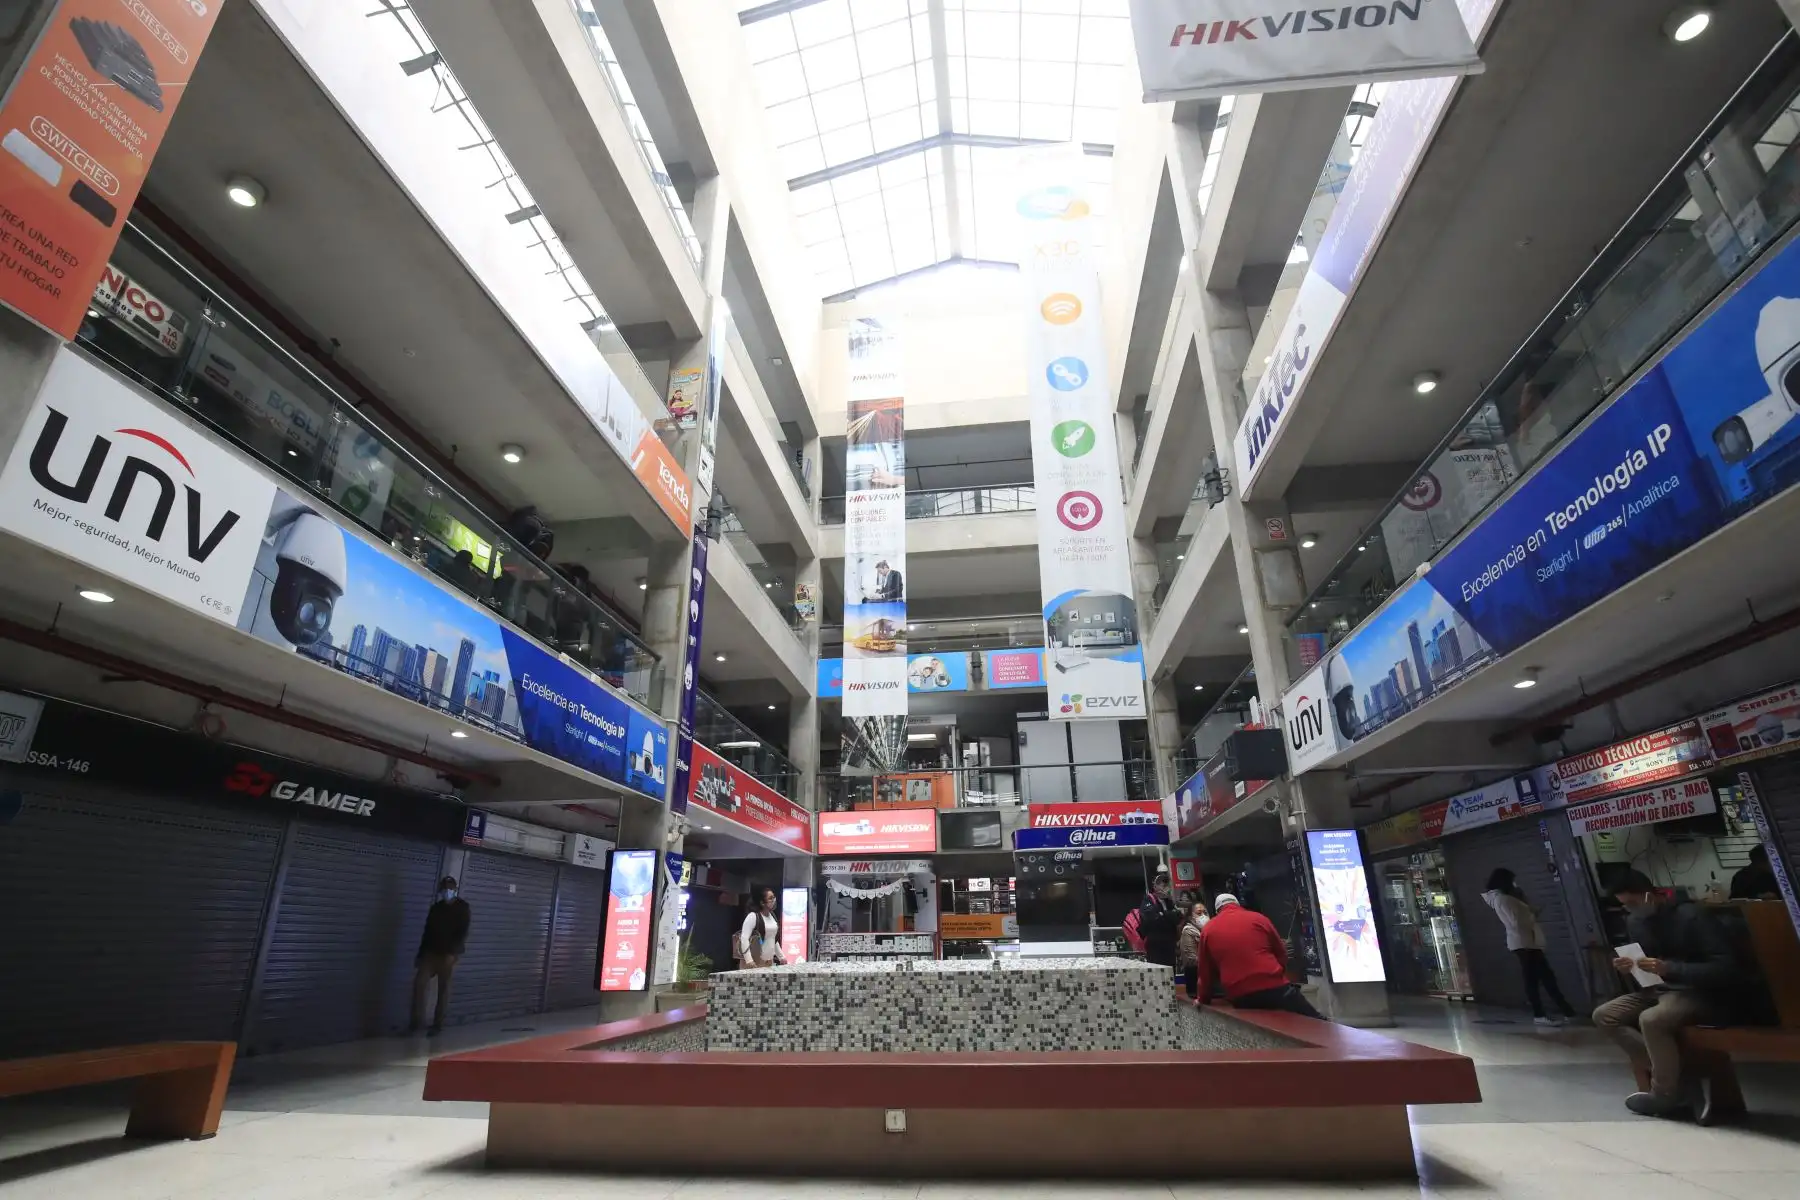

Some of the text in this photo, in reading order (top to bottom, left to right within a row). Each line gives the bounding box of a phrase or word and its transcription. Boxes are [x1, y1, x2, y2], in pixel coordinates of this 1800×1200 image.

[1170, 0, 1421, 47] HIKVISION
[53, 64, 90, 100] ROBUSTA
[96, 103, 126, 132] ESTABLE
[54, 52, 89, 87] HECHOS
[89, 83, 108, 104] PARA
[108, 102, 132, 125] CREAR
[40, 65, 51, 80] DE
[52, 78, 98, 120] SEGURIDAD
[104, 122, 143, 160] VIGILANCIA
[36, 122, 111, 189] SWITCHES
[13, 237, 65, 279] TRABAJO
[28, 228, 54, 251] UNA
[56, 246, 79, 267] RED
[17, 265, 61, 299] HOGAR
[657, 456, 689, 510] Tenda
[849, 492, 902, 504] HIKVISION
[1461, 423, 1672, 603] Excelencia en Tecnología IP
[1536, 550, 1574, 584] Starlight
[1628, 475, 1680, 519] Analítica
[33, 498, 201, 583] Mejor seguridad, Mejor Mundo
[522, 673, 625, 738] Excelencia en Tecnología IP
[849, 680, 900, 691] HIKVISION
[1737, 688, 1798, 713] Smart
[565, 722, 584, 740] Starlight
[1561, 738, 1650, 779] SERVICIO TÉCNICO
[272, 780, 376, 816] GAMER
[1464, 793, 1484, 806] TEAM
[1465, 796, 1510, 813] TECHNOLOGY
[1569, 804, 1612, 822] CELULARES
[1616, 792, 1656, 813] LAPTOPS
[1662, 787, 1676, 801] PC
[1685, 781, 1709, 797] MAC
[1585, 800, 1696, 833] RECUPERACIÓN DE DATOS
[880, 823, 932, 833] HIKVISION
[1035, 813, 1112, 826] HIKVISION
[850, 861, 911, 873] HIKVISION
